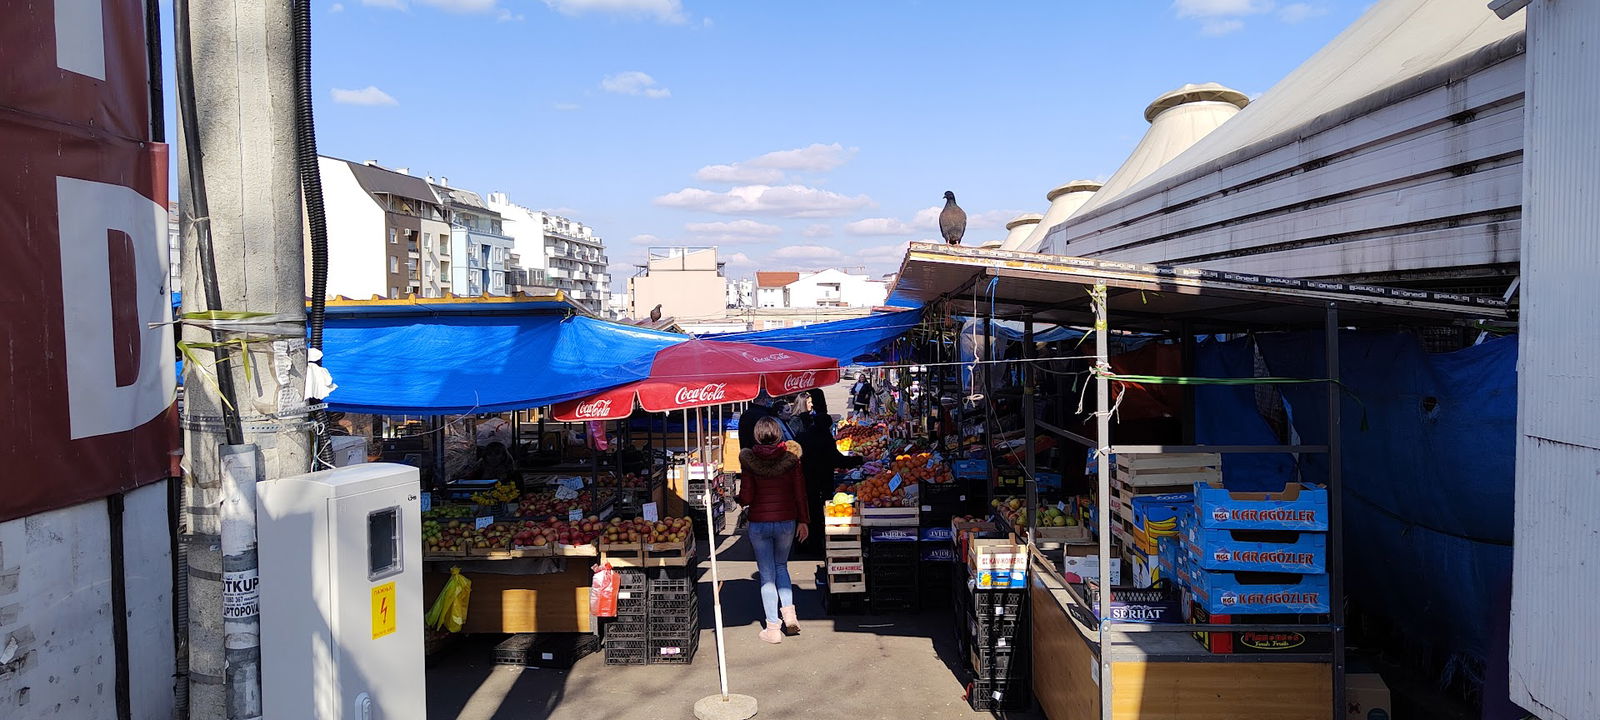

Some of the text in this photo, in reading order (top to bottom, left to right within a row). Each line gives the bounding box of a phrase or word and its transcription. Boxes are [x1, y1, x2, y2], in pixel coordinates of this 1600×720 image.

[56, 176, 177, 440] D
[1231, 508, 1316, 522] KARAGÖZLER
[1233, 549, 1314, 565] KARAGÖZLER
[1238, 590, 1320, 604] KARAGÖZLER
[1112, 609, 1162, 619] SERHAT
